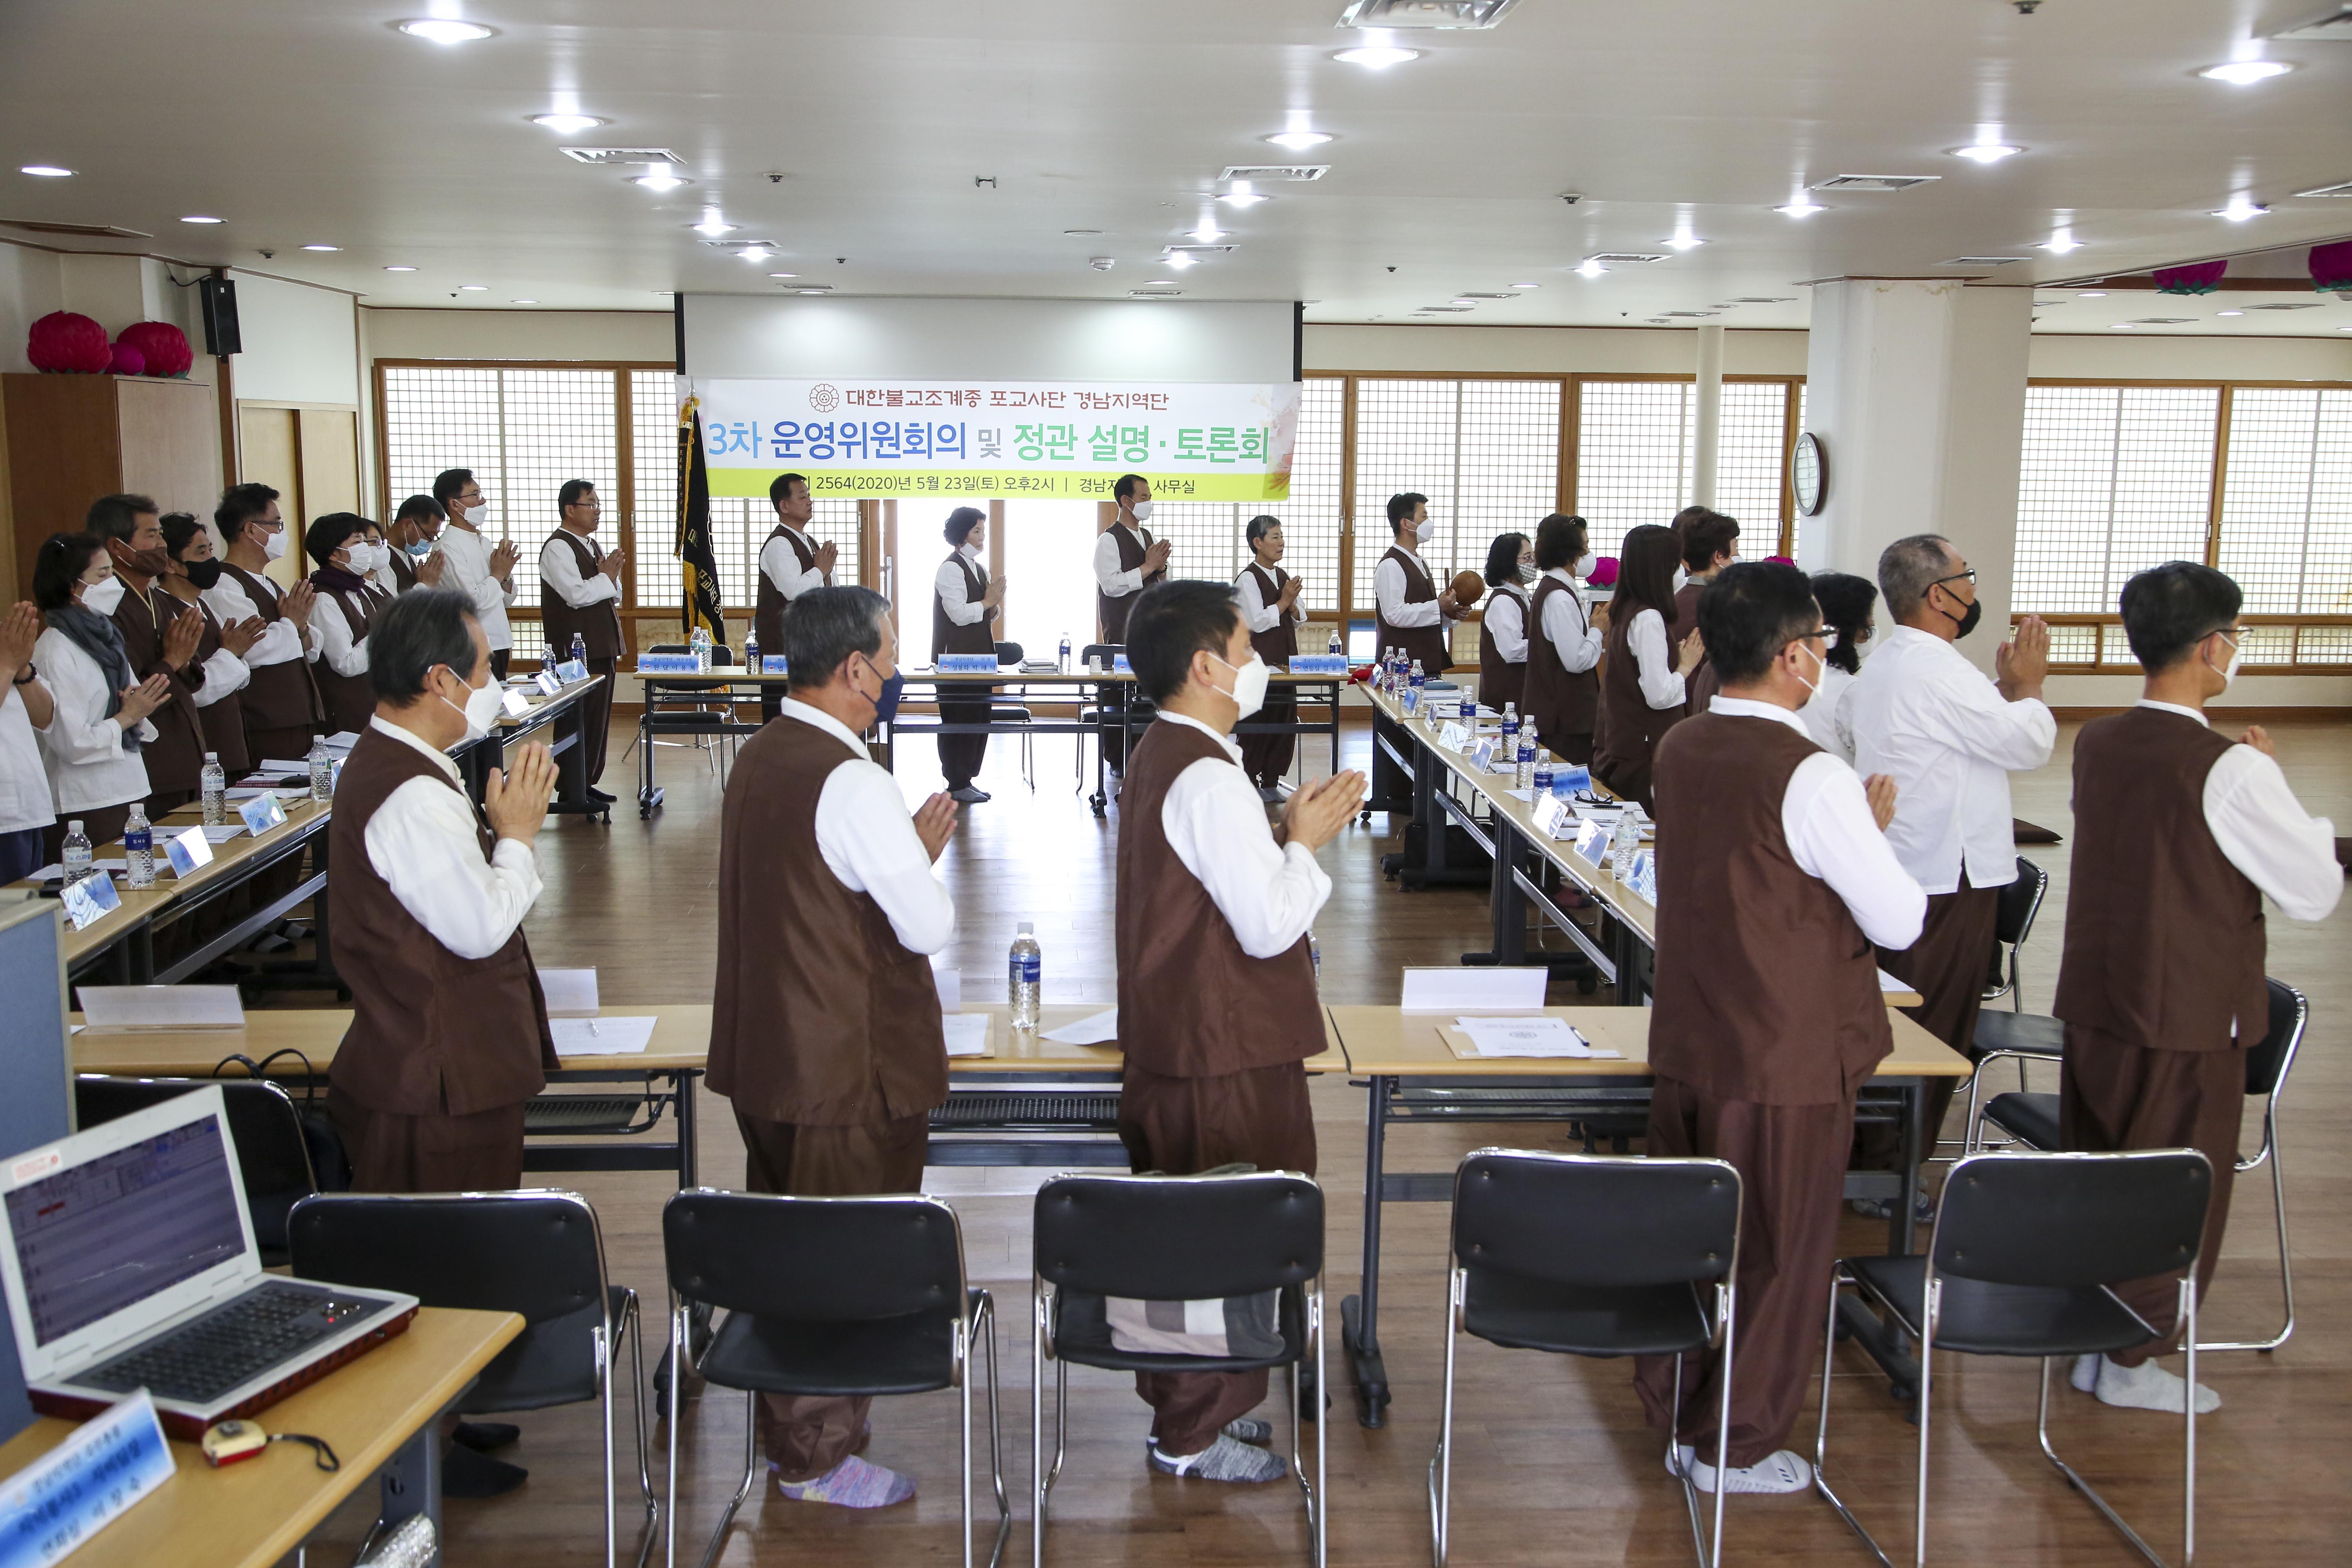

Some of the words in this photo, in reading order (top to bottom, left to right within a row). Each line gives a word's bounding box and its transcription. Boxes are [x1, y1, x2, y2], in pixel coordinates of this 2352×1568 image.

[846, 389, 982, 408] 대한불교조계종
[989, 390, 1067, 409] 포교사단
[1073, 391, 1169, 410] 경남지역단
[708, 421, 762, 459] 3차
[770, 421, 965, 460] 운영위원회의
[978, 428, 1002, 459] 및
[1013, 423, 1078, 461] 정관
[816, 475, 911, 491] 2564(2020)년
[917, 476, 939, 490] 5월
[944, 475, 999, 491] 23일(토)
[1003, 477, 1054, 492] 오후2시
[1154, 479, 1195, 494] 사무실
